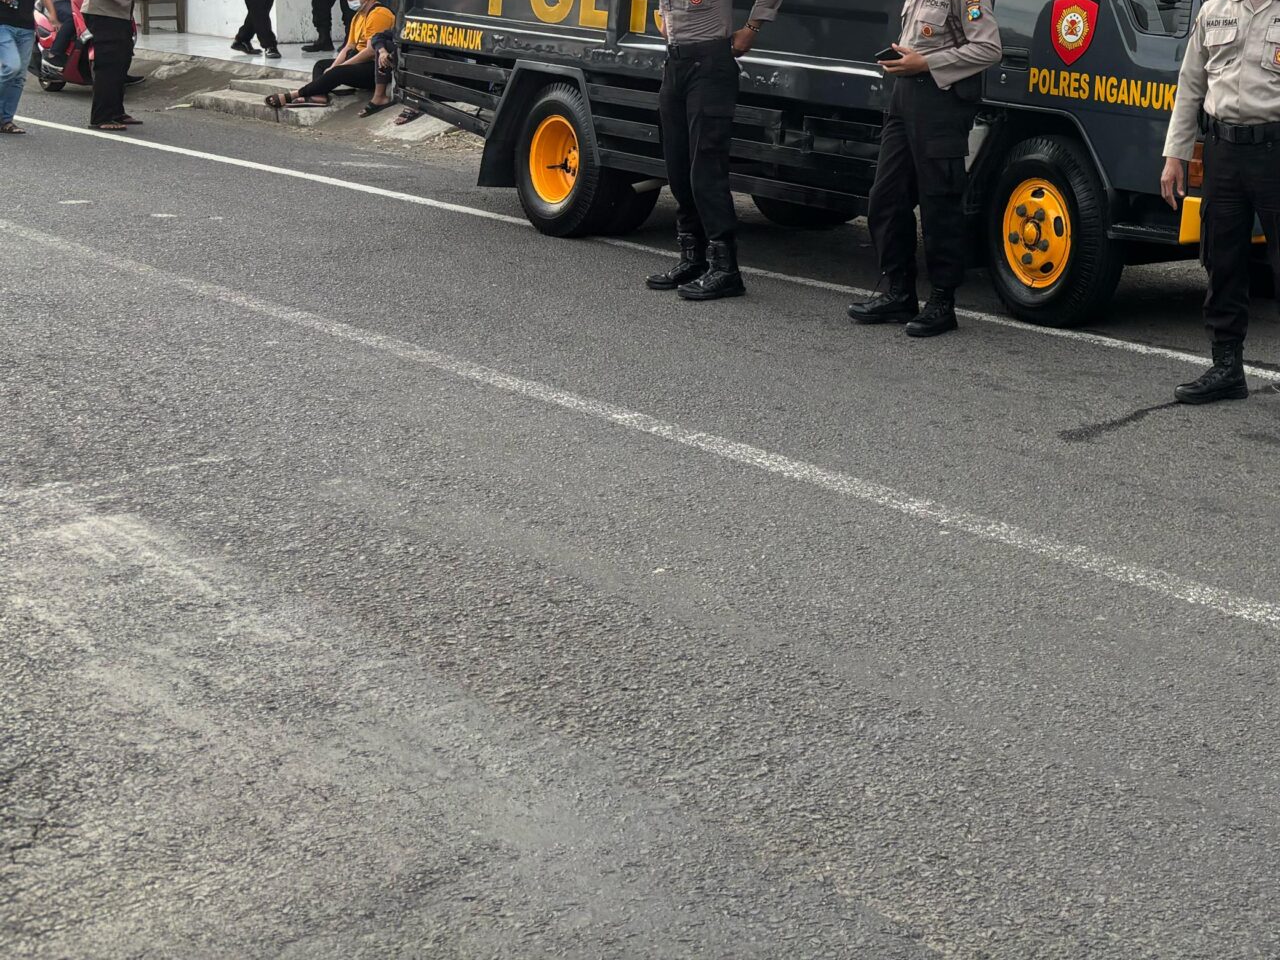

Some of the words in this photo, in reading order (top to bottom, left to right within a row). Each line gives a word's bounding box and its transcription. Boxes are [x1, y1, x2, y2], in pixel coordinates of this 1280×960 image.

[405, 20, 439, 44] POLRES
[440, 25, 483, 51] NGANJUK
[1206, 20, 1221, 28] HADI
[1029, 67, 1089, 100] POLRES
[1094, 74, 1178, 112] NGANJUK
